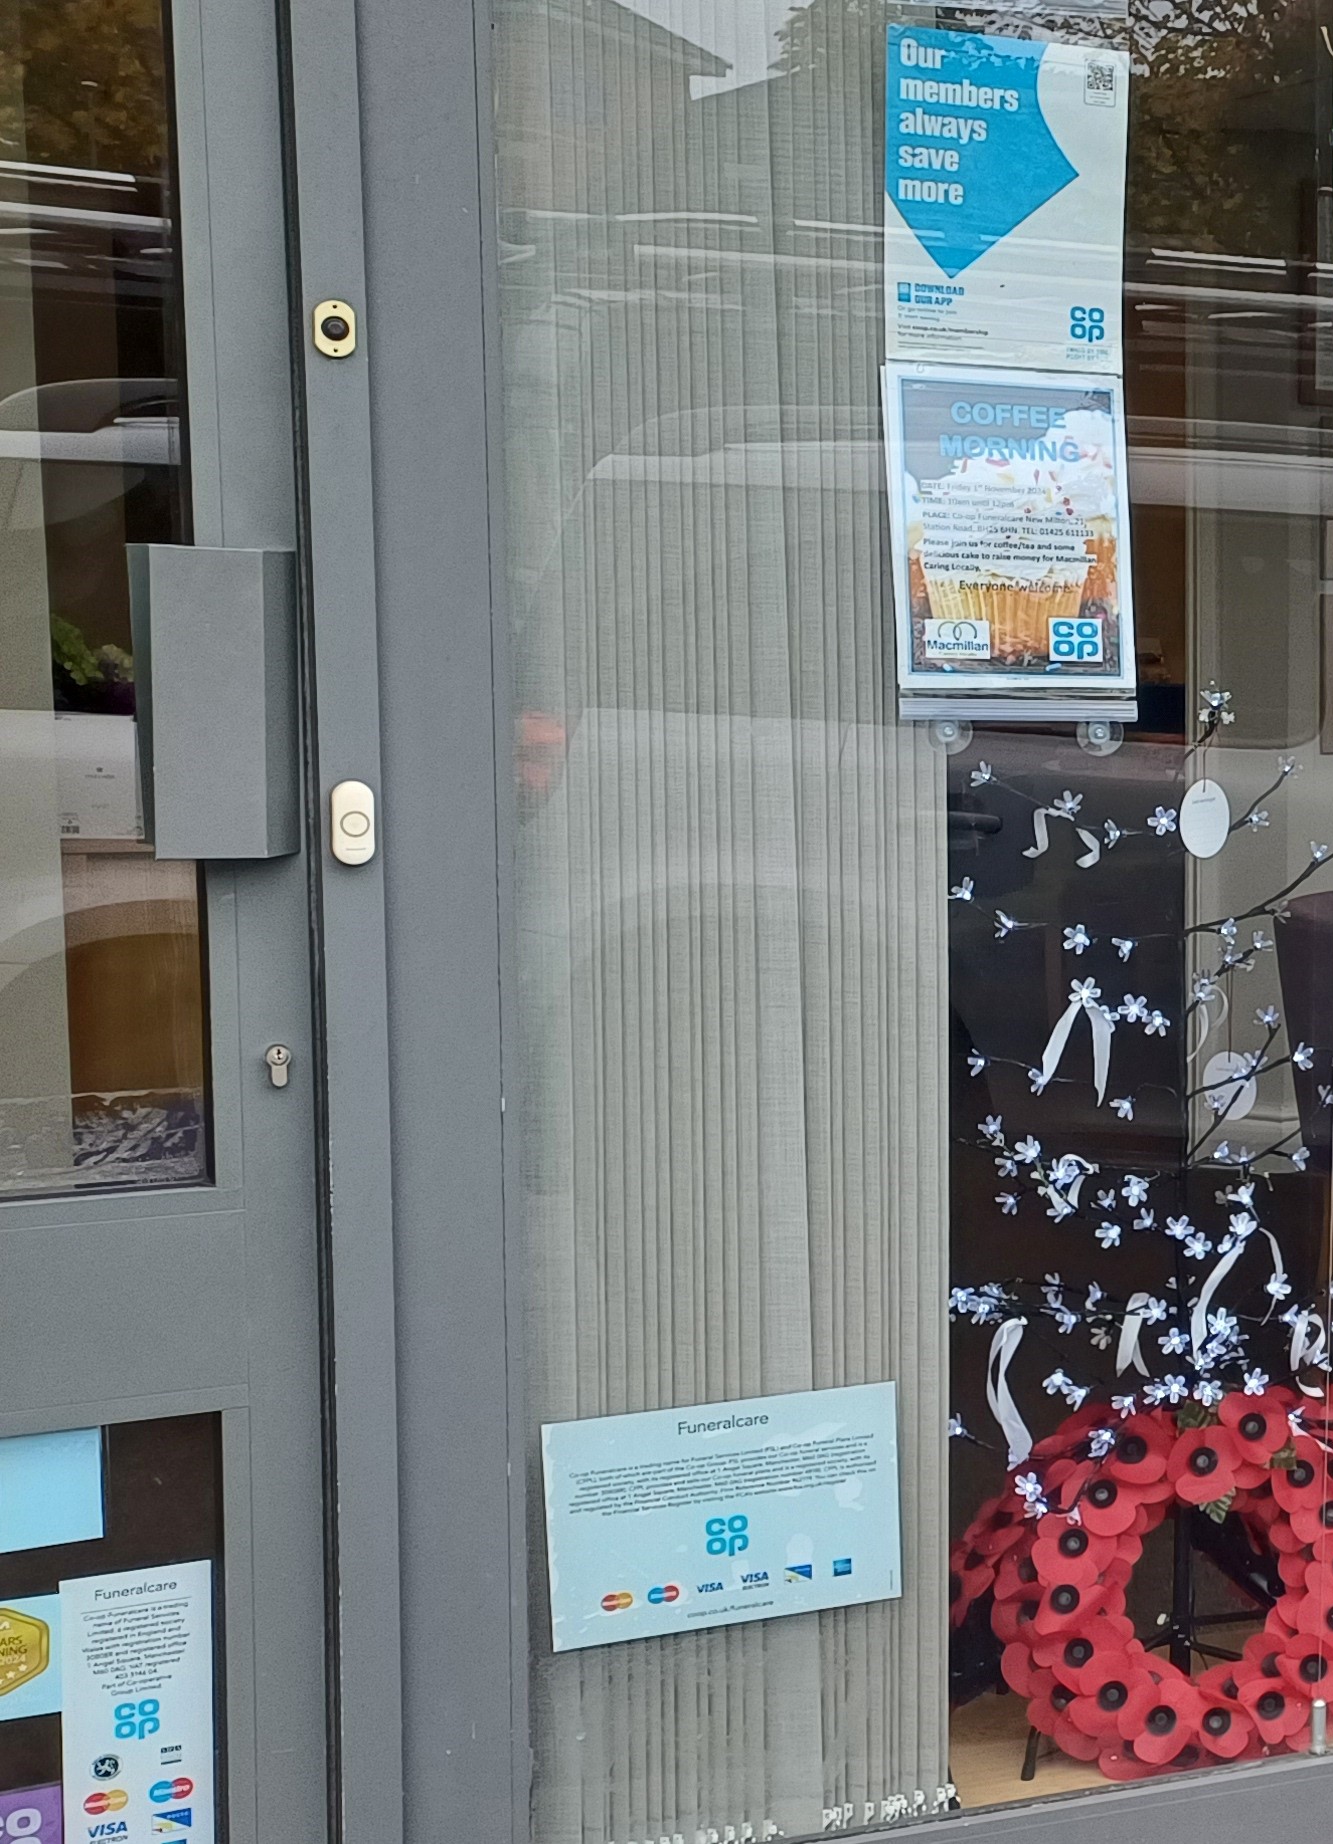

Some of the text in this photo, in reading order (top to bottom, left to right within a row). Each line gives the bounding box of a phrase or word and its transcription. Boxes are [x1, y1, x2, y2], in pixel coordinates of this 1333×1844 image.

[900, 37, 945, 69] Our
[899, 77, 1019, 112] members
[899, 107, 987, 144] always
[898, 145, 960, 172] save
[898, 178, 964, 205] more
[950, 401, 1067, 429] COFFEE
[939, 434, 1080, 463] MORNING
[927, 639, 989, 652] Macmillan
[678, 1414, 769, 1435] Funeralcare
[94, 1581, 177, 1600] Funeralcare
[697, 1582, 724, 1593] VISA
[740, 1571, 769, 1584] VISA
[87, 1821, 128, 1838] VISA
